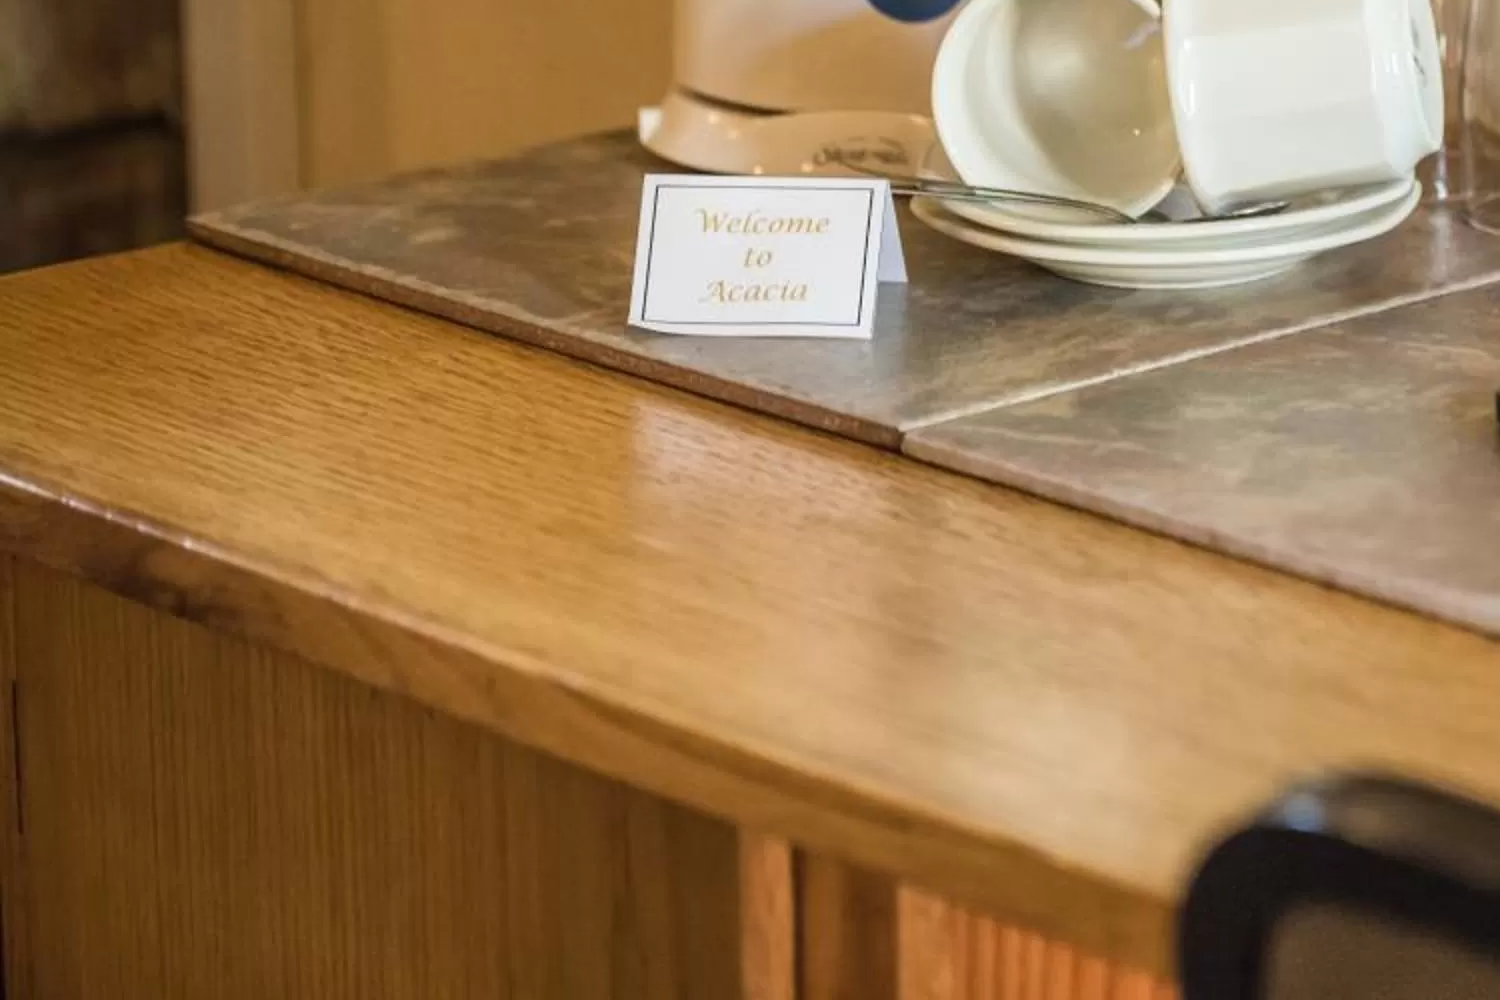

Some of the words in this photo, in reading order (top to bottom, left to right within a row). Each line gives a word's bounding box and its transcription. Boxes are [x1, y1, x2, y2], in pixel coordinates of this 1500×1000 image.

[694, 208, 831, 234] Welcome
[744, 247, 773, 269] to
[702, 279, 808, 302] Acacia
